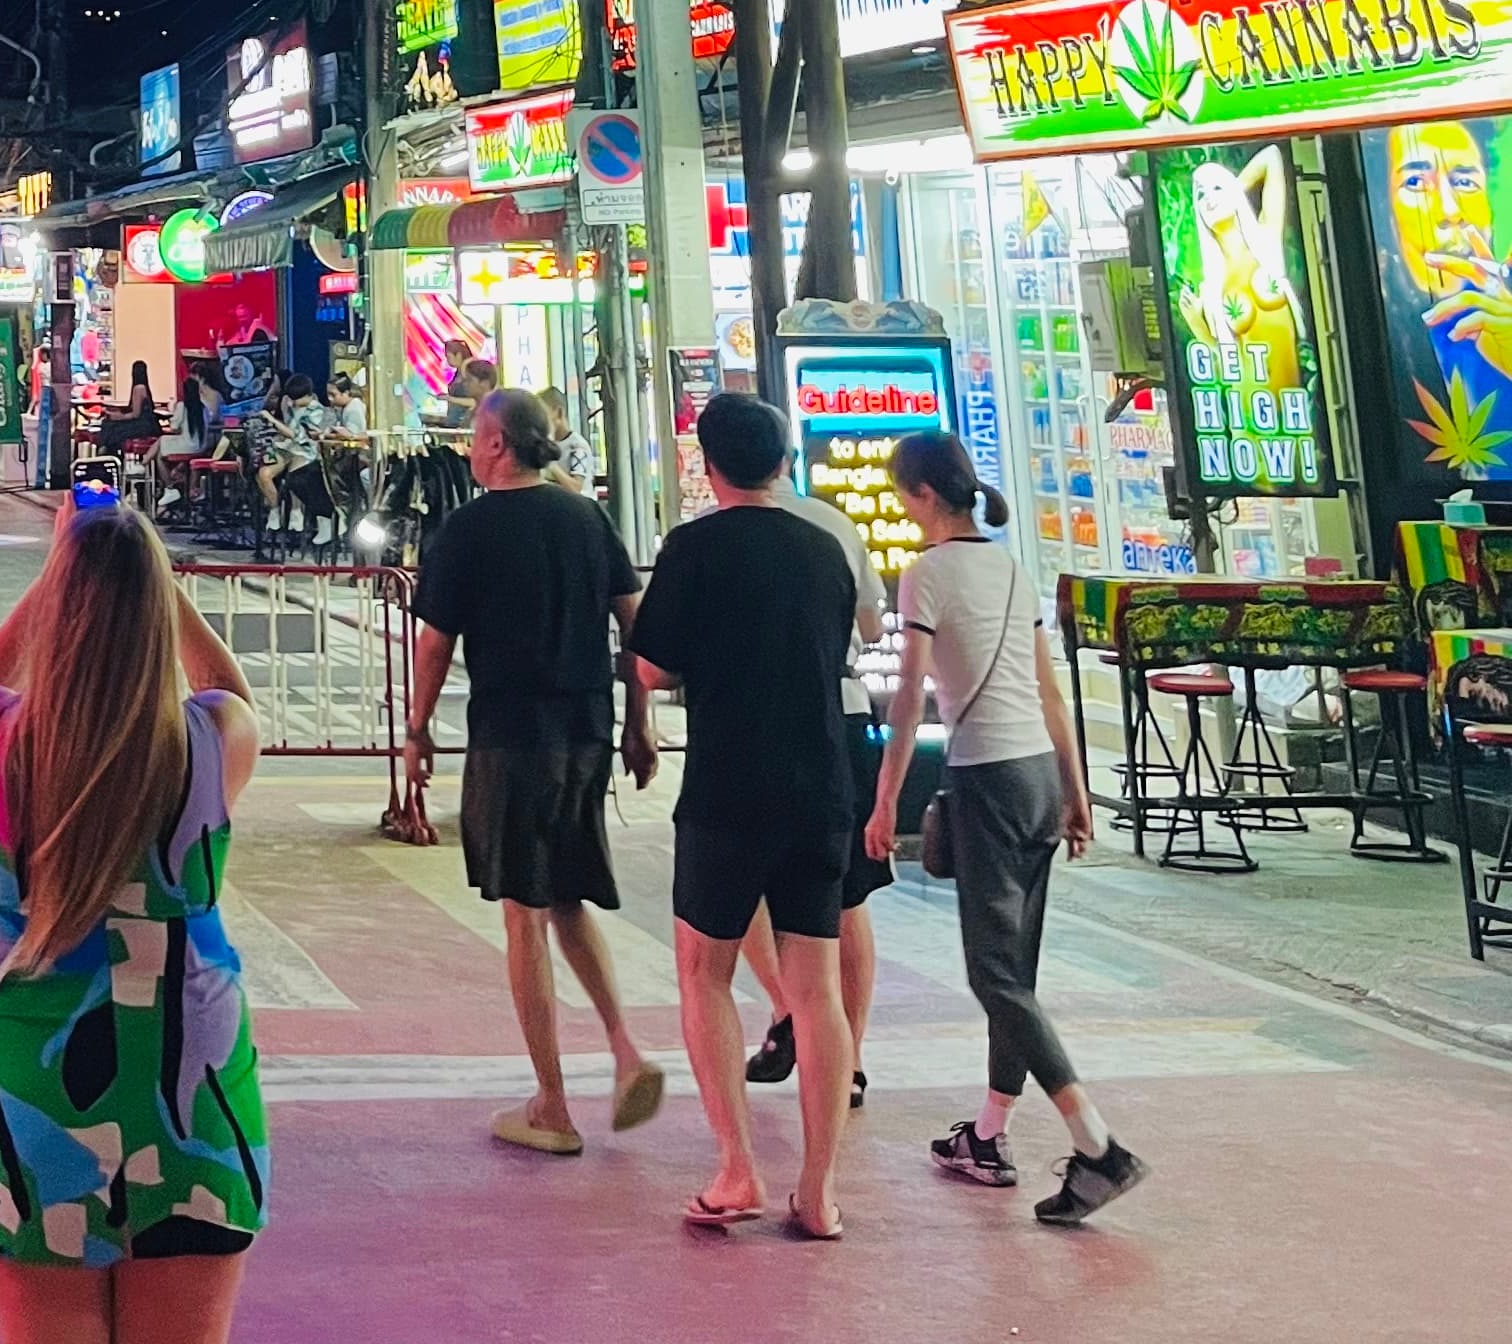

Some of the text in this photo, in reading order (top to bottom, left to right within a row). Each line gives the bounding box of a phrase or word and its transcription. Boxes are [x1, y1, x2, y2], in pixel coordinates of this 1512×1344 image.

[983, 17, 1118, 120] HAPPY
[1188, 341, 1271, 384] GET
[798, 383, 938, 414] Guideline
[1193, 388, 1311, 433] HIGH
[1197, 434, 1319, 483] NOW!
